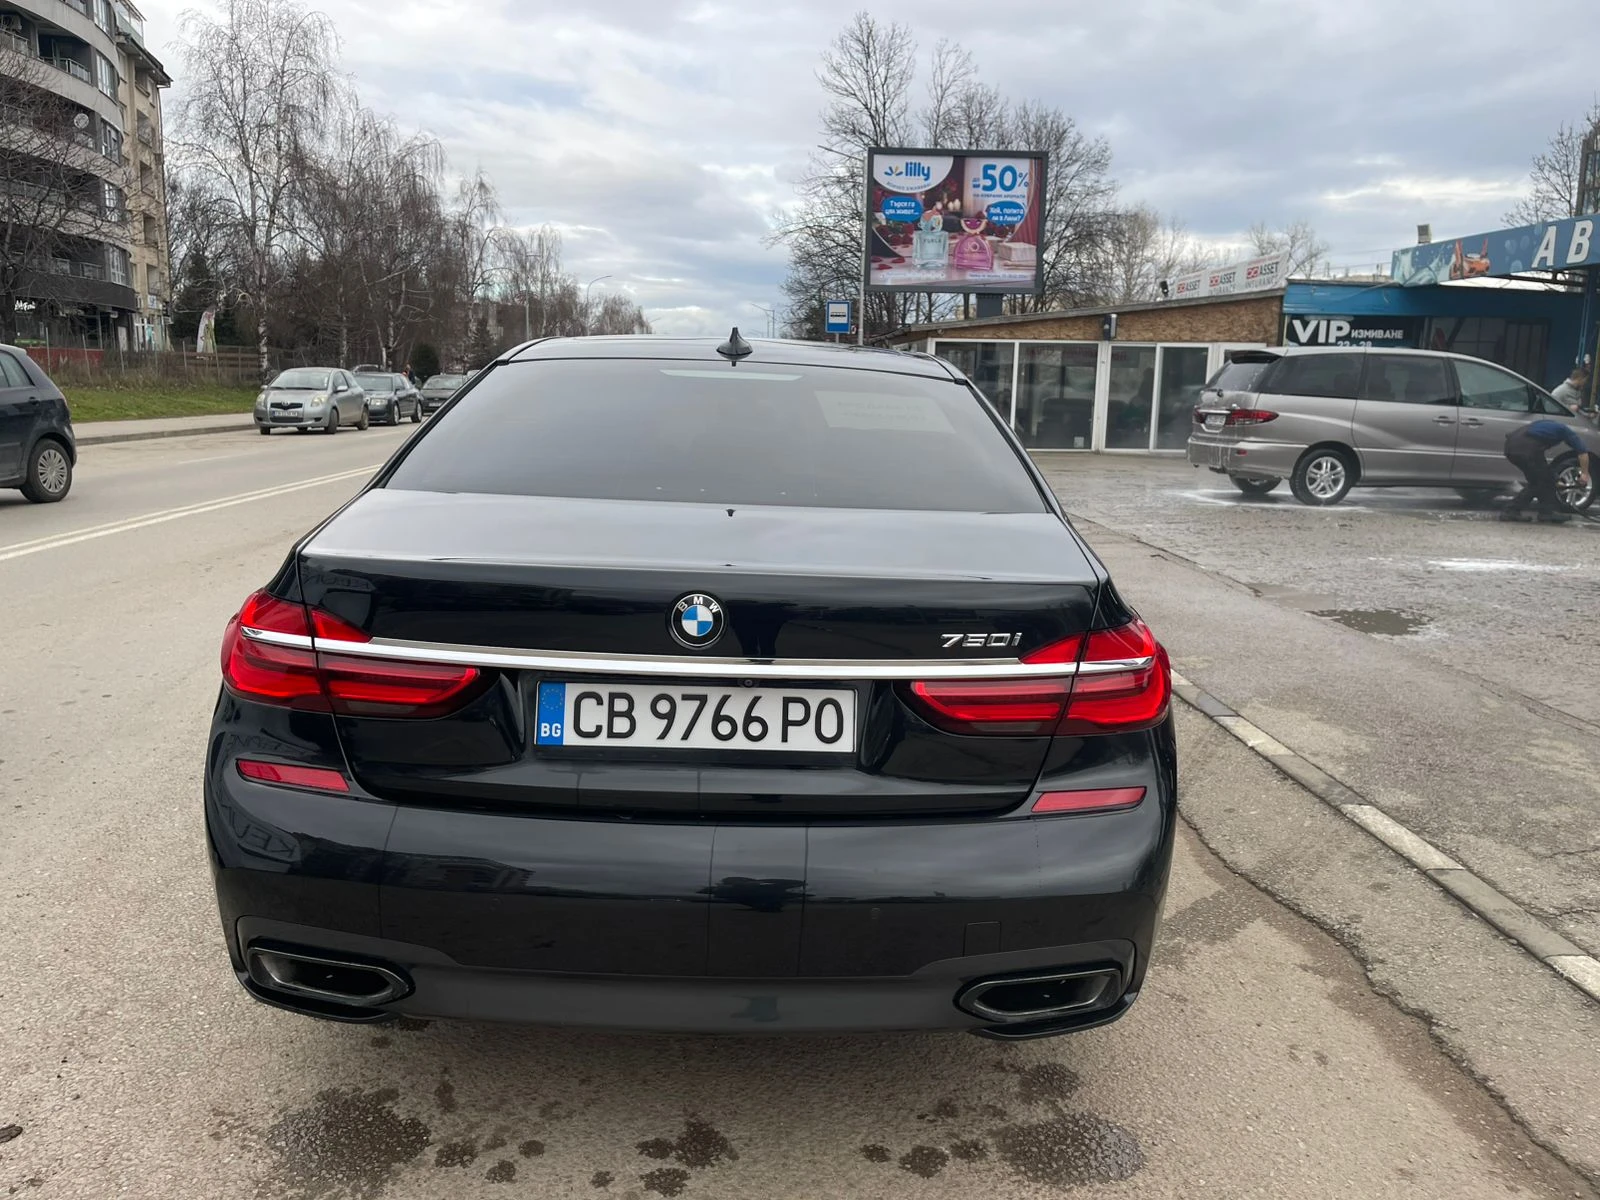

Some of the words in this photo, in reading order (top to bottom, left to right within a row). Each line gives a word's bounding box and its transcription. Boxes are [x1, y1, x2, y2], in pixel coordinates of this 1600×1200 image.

[905, 162, 931, 181] lilly
[1292, 319, 1351, 344] VIP
[1351, 329, 1404, 339] ИЗМИВАНЕ
[677, 596, 720, 612] BMW
[941, 632, 1022, 648] 750i
[573, 691, 637, 739] CB
[650, 693, 769, 742] 9766
[781, 696, 844, 744] PO
[540, 723, 562, 738] BG
